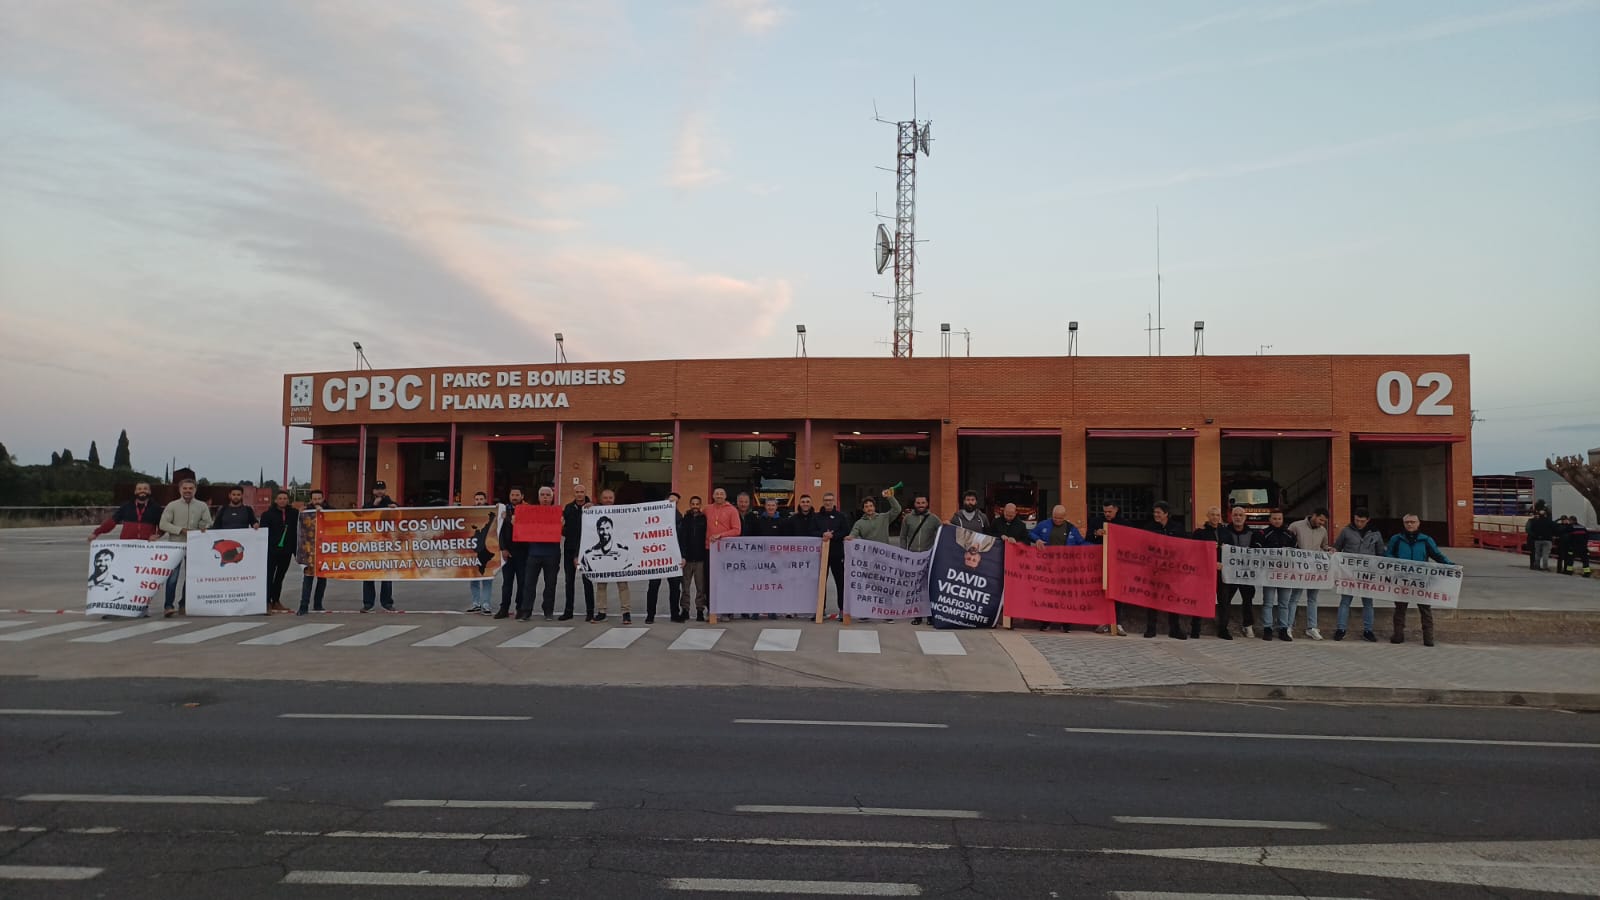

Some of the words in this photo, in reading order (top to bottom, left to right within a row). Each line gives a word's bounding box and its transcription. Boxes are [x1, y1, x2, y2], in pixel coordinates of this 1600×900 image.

[443, 372, 491, 388] PARC
[497, 371, 522, 386] DE
[528, 369, 626, 386] BOMBERS
[322, 374, 423, 412] CPBC
[1376, 370, 1454, 416] 02
[442, 394, 504, 410] PLANA
[509, 392, 569, 409] BAIXA
[347, 521, 372, 533] PER
[376, 520, 394, 532] UN
[399, 519, 428, 532] COS
[431, 516, 465, 531] ÚNIC
[645, 516, 660, 525] JO
[633, 526, 673, 540] TAMBÉ
[321, 542, 338, 554] DE
[341, 540, 401, 553] BOMBERS
[405, 541, 409, 551] I
[412, 538, 478, 551] BOMBERES
[642, 543, 666, 553] SÓC
[725, 542, 763, 552] FALTAN
[769, 544, 821, 553] BOMBEROS
[873, 547, 885, 555] NO
[1230, 546, 1307, 558] BIENVENIDOS
[150, 553, 168, 561] JO
[638, 557, 672, 567] JORDI
[321, 562, 330, 571] A
[333, 562, 346, 571] LA
[349, 560, 413, 570] COMUNITAT
[415, 558, 482, 568] VALENCIANA
[726, 562, 746, 570] POR
[758, 561, 776, 570] UNA
[792, 561, 810, 569] RPT
[874, 562, 916, 578] MOTIVOS
[1229, 559, 1309, 570] CHIRINGUITO
[1341, 558, 1369, 567] JEFE
[1378, 562, 1462, 578] OPERACIONES
[947, 568, 987, 588] DAVID
[1236, 570, 1255, 578] LAS
[1270, 572, 1328, 581] JEFATURAS
[1357, 573, 1425, 588] INFINITAS
[865, 584, 900, 597] PORQUE
[938, 580, 990, 605] VICENTE
[1334, 580, 1448, 602] CONTRADICCIONES
[857, 595, 883, 604] PARTE
[938, 595, 976, 611] MAFIOSO
[978, 606, 983, 614] E
